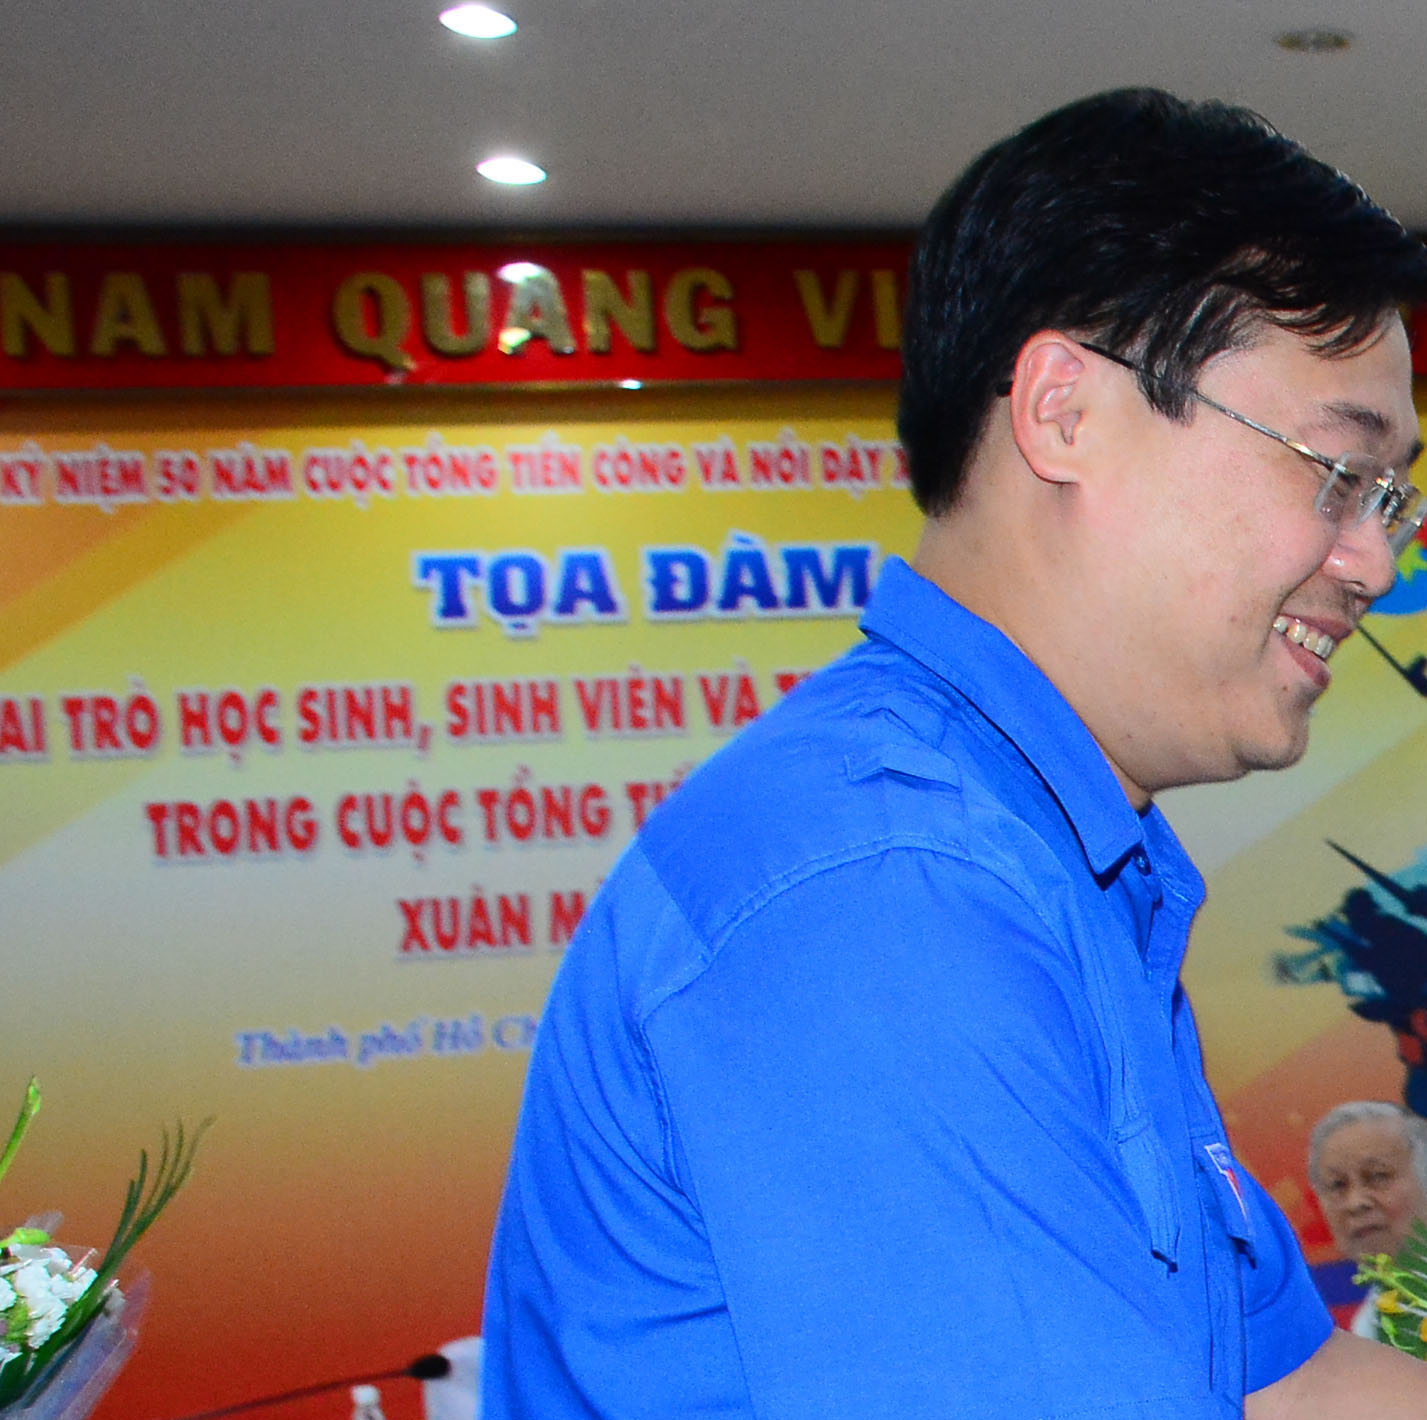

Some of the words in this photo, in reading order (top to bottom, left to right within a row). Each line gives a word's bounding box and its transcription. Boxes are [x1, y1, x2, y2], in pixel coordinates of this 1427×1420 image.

[0, 272, 276, 357] NAM
[333, 264, 740, 371] QUANG
[794, 269, 901, 350] VI
[54, 444, 146, 512] NIỆM
[158, 450, 200, 497] 50
[211, 441, 292, 495] NĂM
[303, 439, 396, 509] CUỘC
[592, 435, 688, 488] CÔNG
[695, 436, 740, 485] VÀ
[415, 549, 621, 632] TỌA
[644, 530, 874, 615] ĐÀM
[0, 694, 47, 755] AI
[61, 676, 160, 755] TRÒ
[176, 688, 281, 765] HỌC
[297, 686, 432, 753] SINH,
[446, 679, 560, 739] SINH
[573, 663, 687, 734] VIÊN
[698, 656, 762, 730] VÀ
[145, 795, 319, 860] TRONG
[336, 779, 463, 867] CUỘC
[474, 764, 613, 842] TỔNG
[396, 884, 534, 954] XUÂN
[236, 1024, 347, 1064] Thành
[356, 1016, 429, 1067] phố
